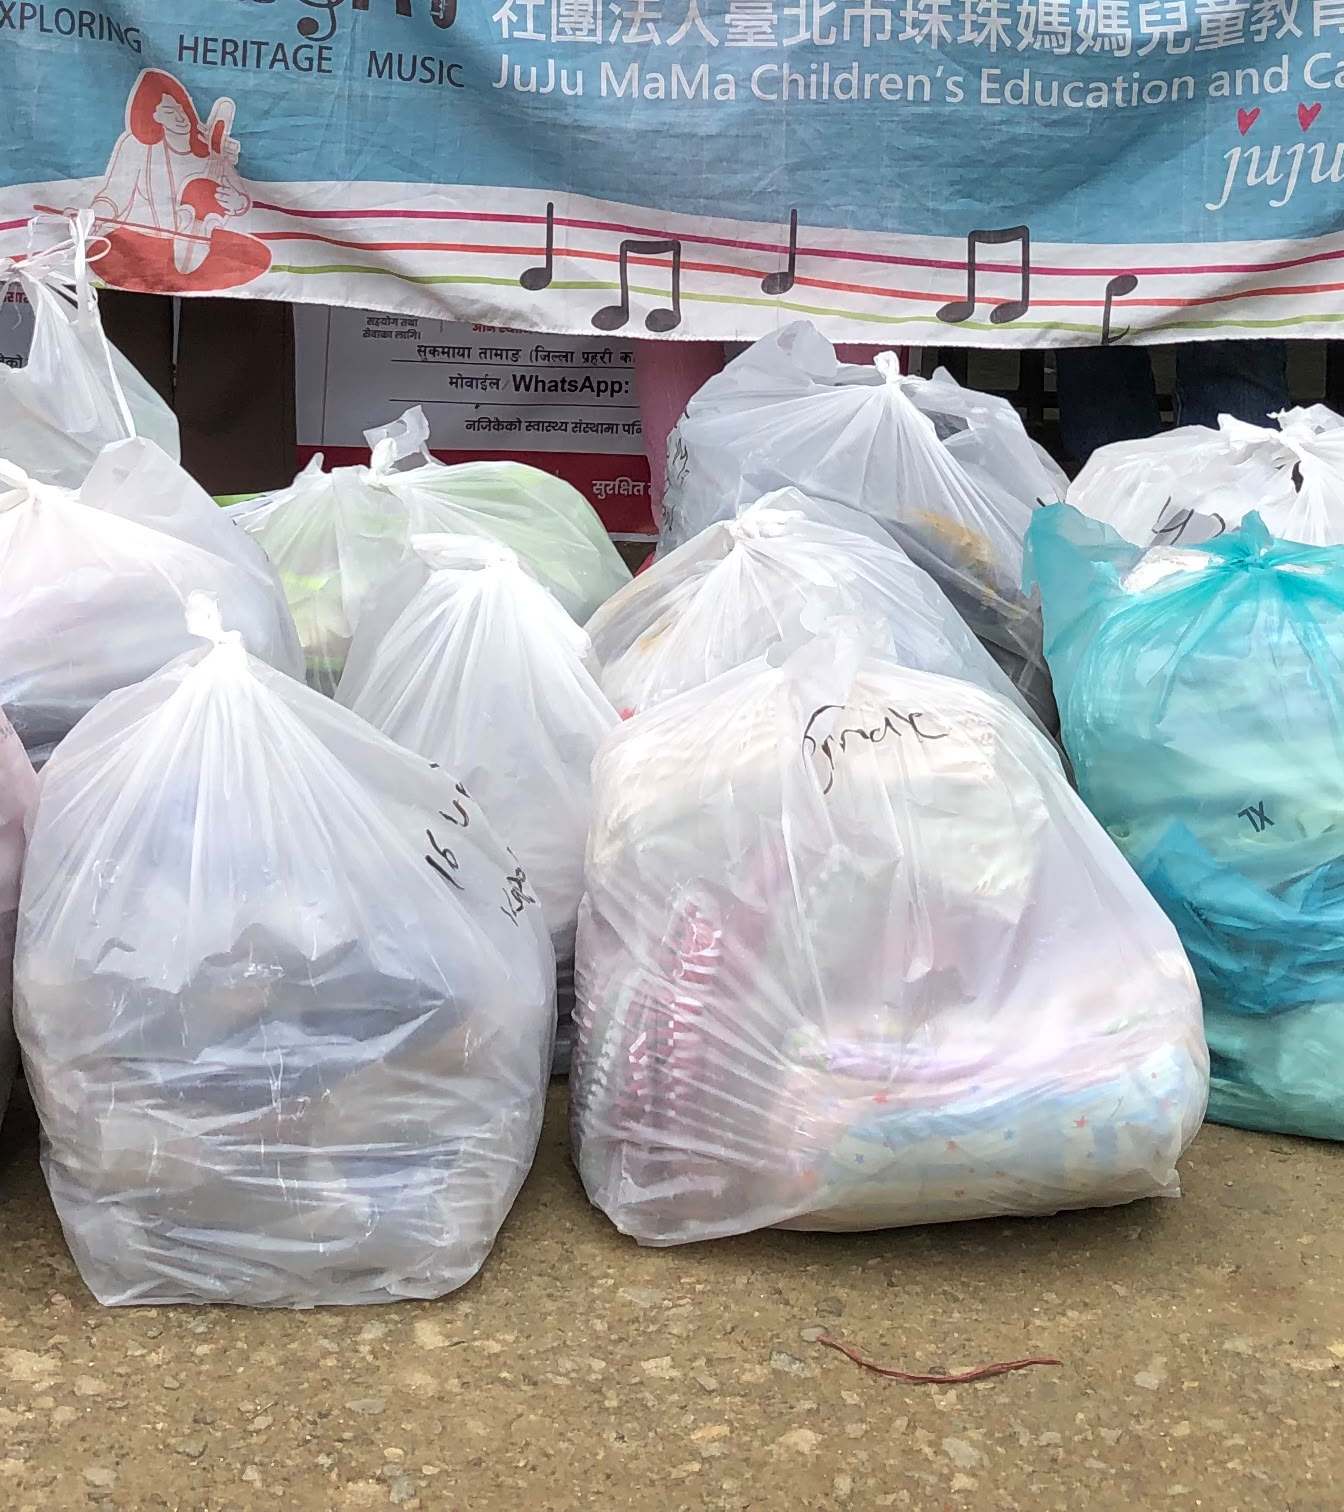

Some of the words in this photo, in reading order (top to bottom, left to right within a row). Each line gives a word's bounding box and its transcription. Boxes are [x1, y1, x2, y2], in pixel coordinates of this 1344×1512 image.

[176, 34, 334, 74] HERITAGE
[365, 49, 465, 88] MUSIC
[492, 53, 584, 97] JuJu
[599, 60, 738, 103] MaMa
[978, 67, 1197, 110] Education
[1208, 54, 1289, 98] and
[416, 344, 471, 361] सुकमाया
[581, 348, 613, 366] प्रहरी
[511, 373, 631, 397] WhatsApp:
